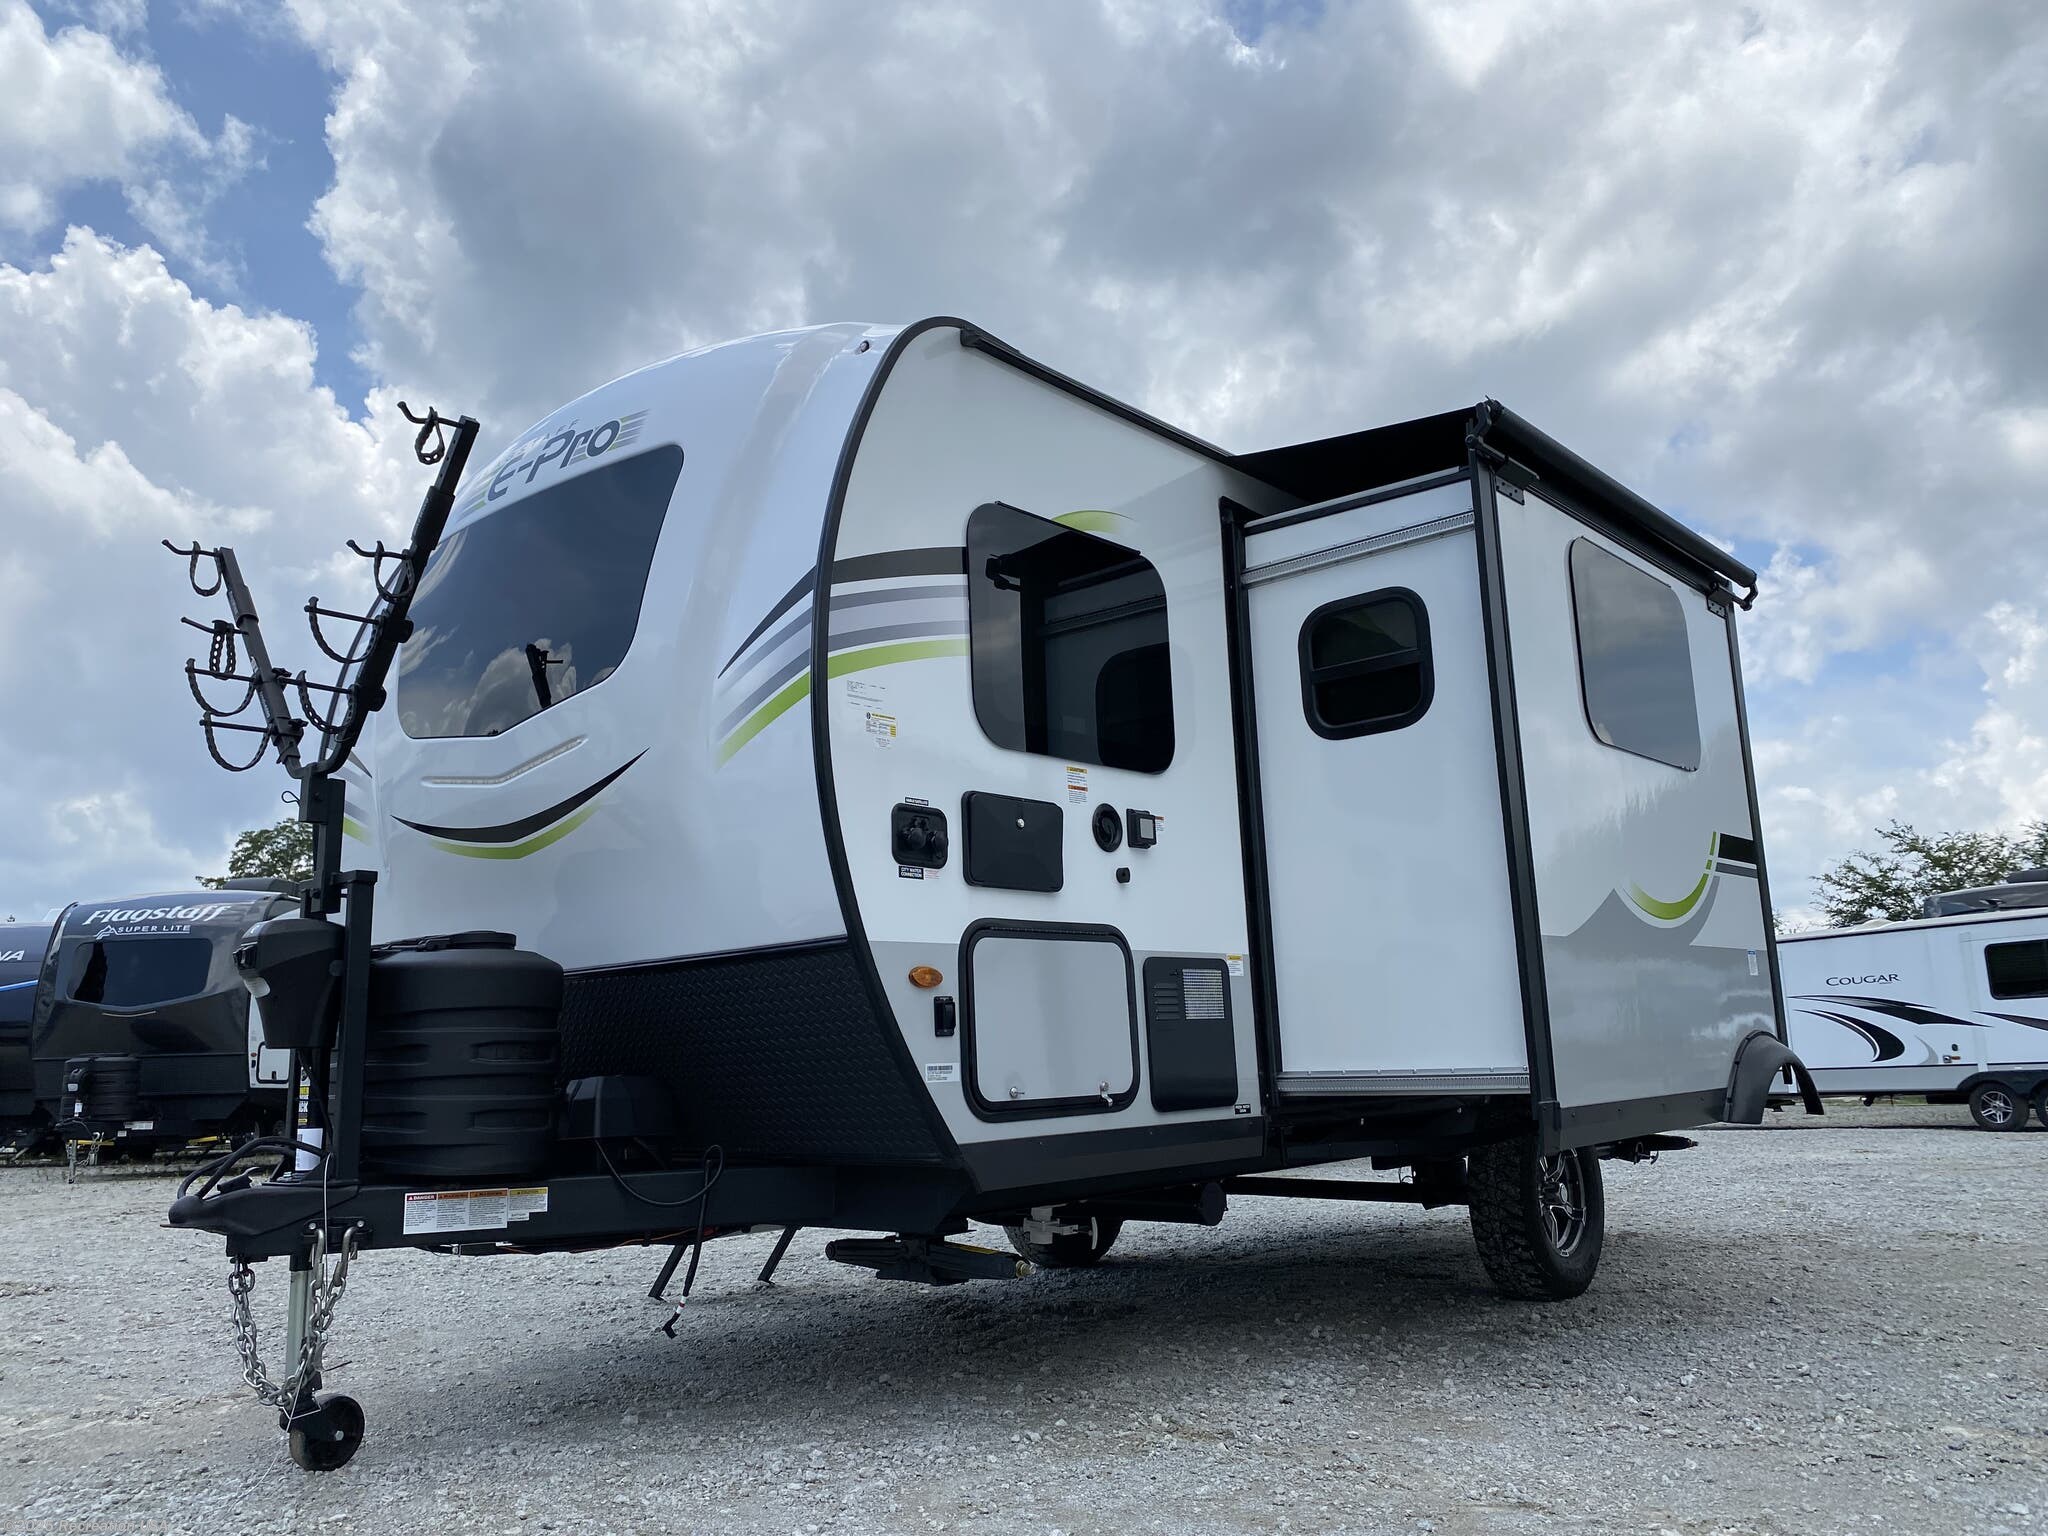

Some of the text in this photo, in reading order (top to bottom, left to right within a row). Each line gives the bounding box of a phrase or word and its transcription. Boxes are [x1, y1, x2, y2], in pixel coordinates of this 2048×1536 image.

[82, 905, 232, 925] Flagstaff
[118, 924, 191, 933] SUPER LITE
[1825, 974, 1901, 986] COUGAR
